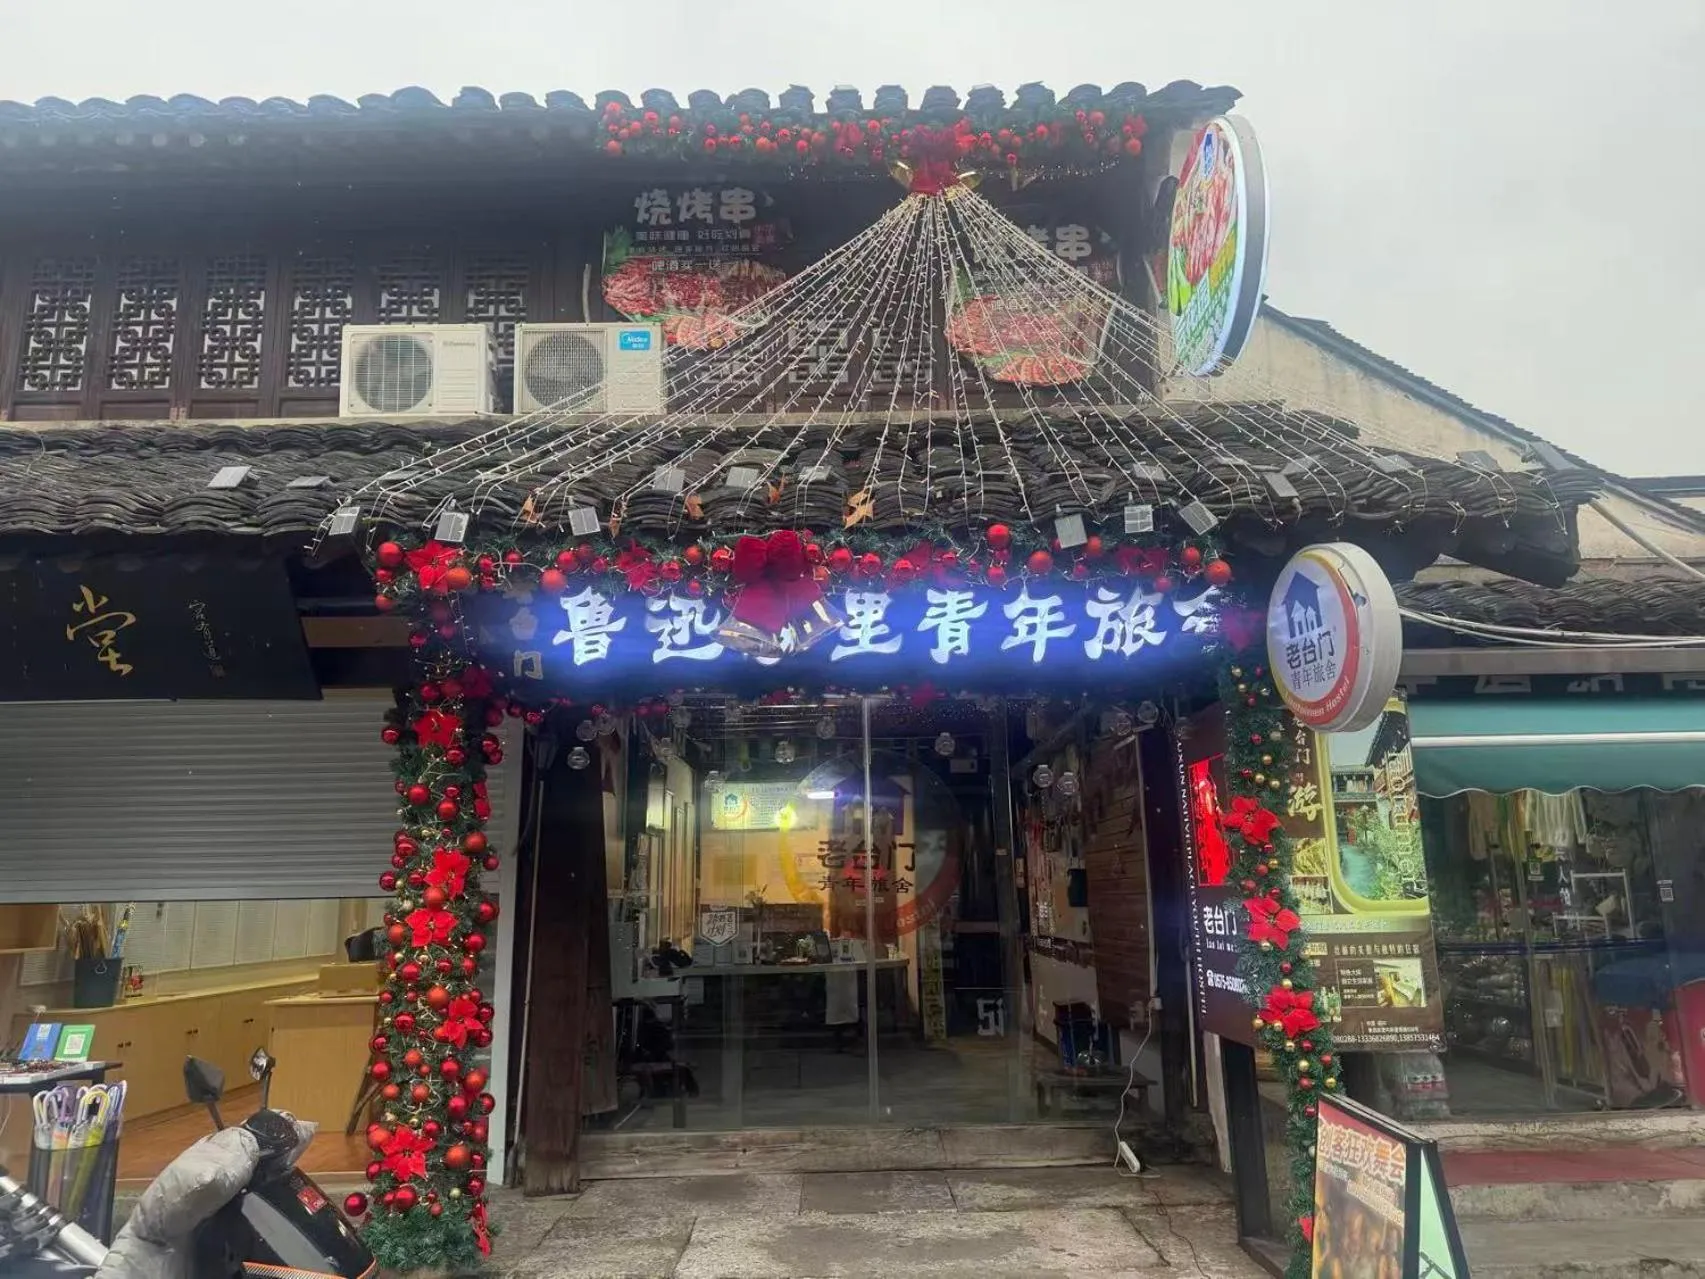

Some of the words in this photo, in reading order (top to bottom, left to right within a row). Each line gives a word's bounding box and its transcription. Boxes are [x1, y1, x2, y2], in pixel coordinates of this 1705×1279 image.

[634, 187, 757, 225] 烧烤串
[552, 585, 1221, 667] 鲁迅里青年旅
[1285, 630, 1336, 670] 老台门
[1290, 659, 1337, 691] 青年旅舍
[817, 839, 917, 872] 老台门
[817, 874, 915, 895] 青年旅舍
[1203, 905, 1237, 935] 老台门
